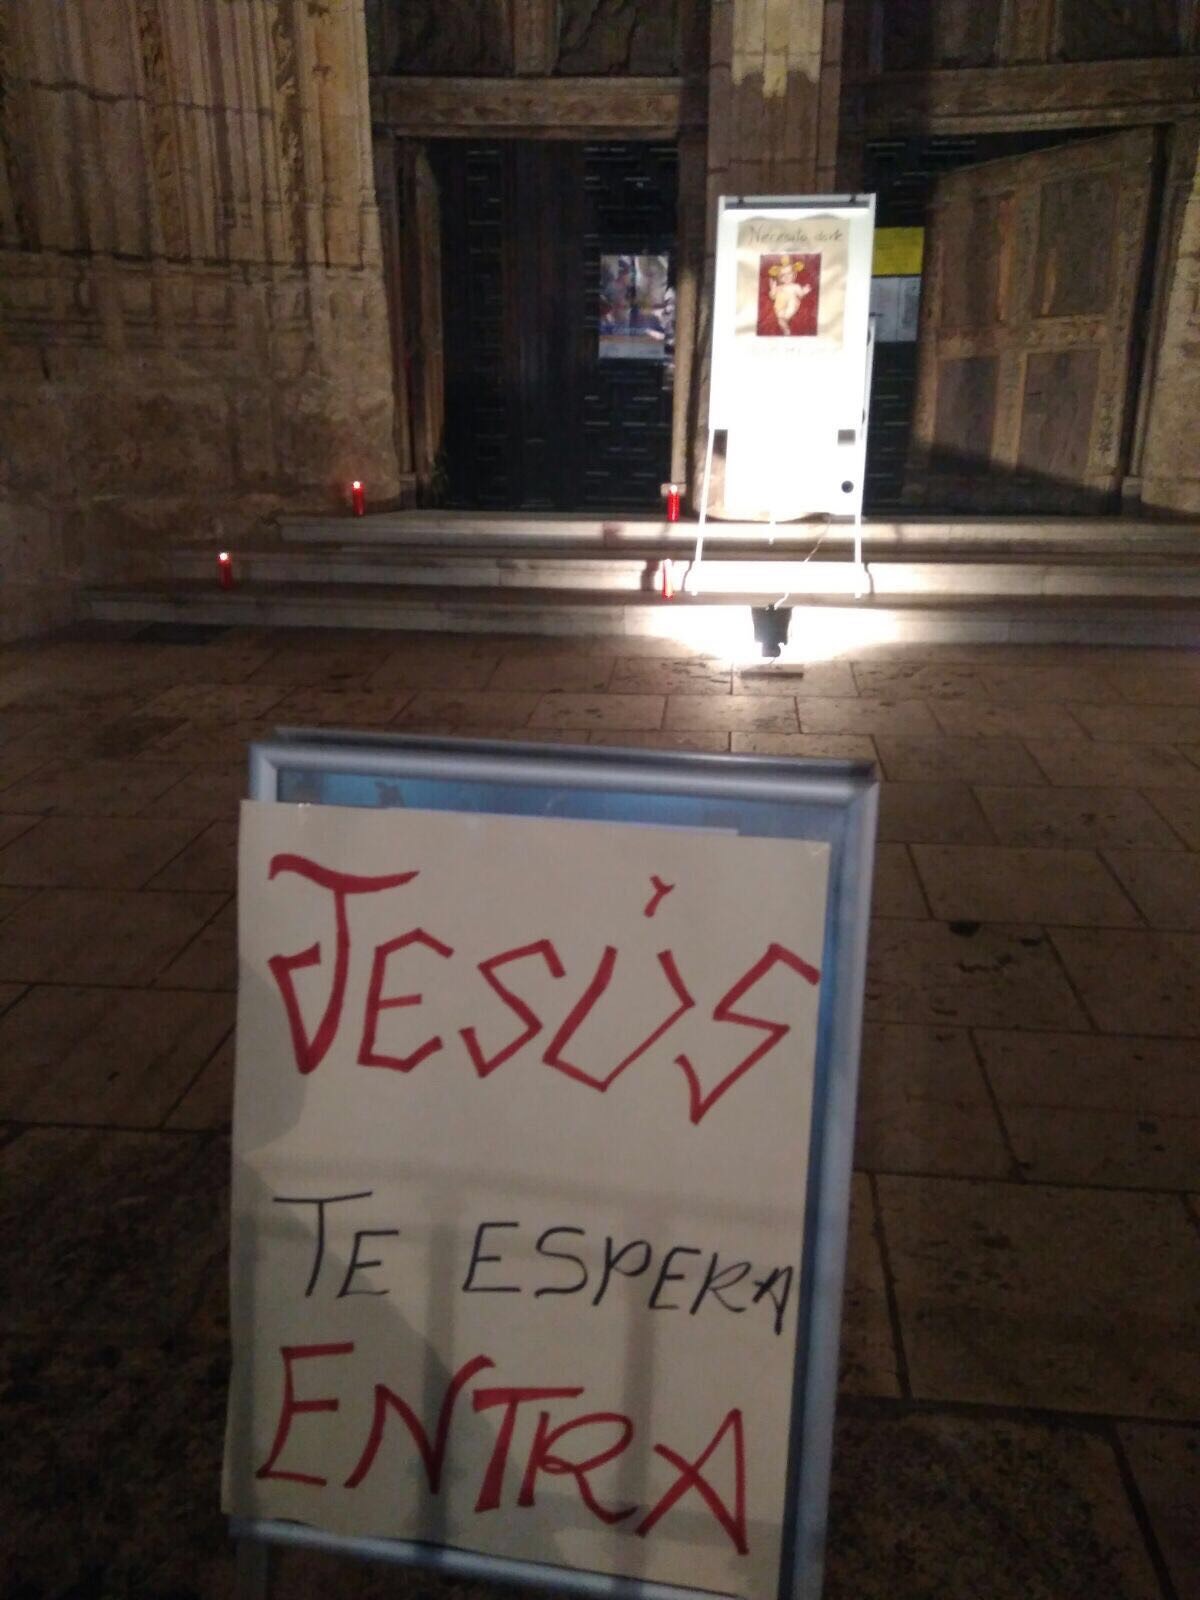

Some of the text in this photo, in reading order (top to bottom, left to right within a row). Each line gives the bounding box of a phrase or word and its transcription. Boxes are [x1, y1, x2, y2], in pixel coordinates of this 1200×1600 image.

[267, 853, 821, 1125] JESÚS
[272, 1191, 795, 1336] TE ESPERA
[256, 1341, 749, 1556] ENTRA
